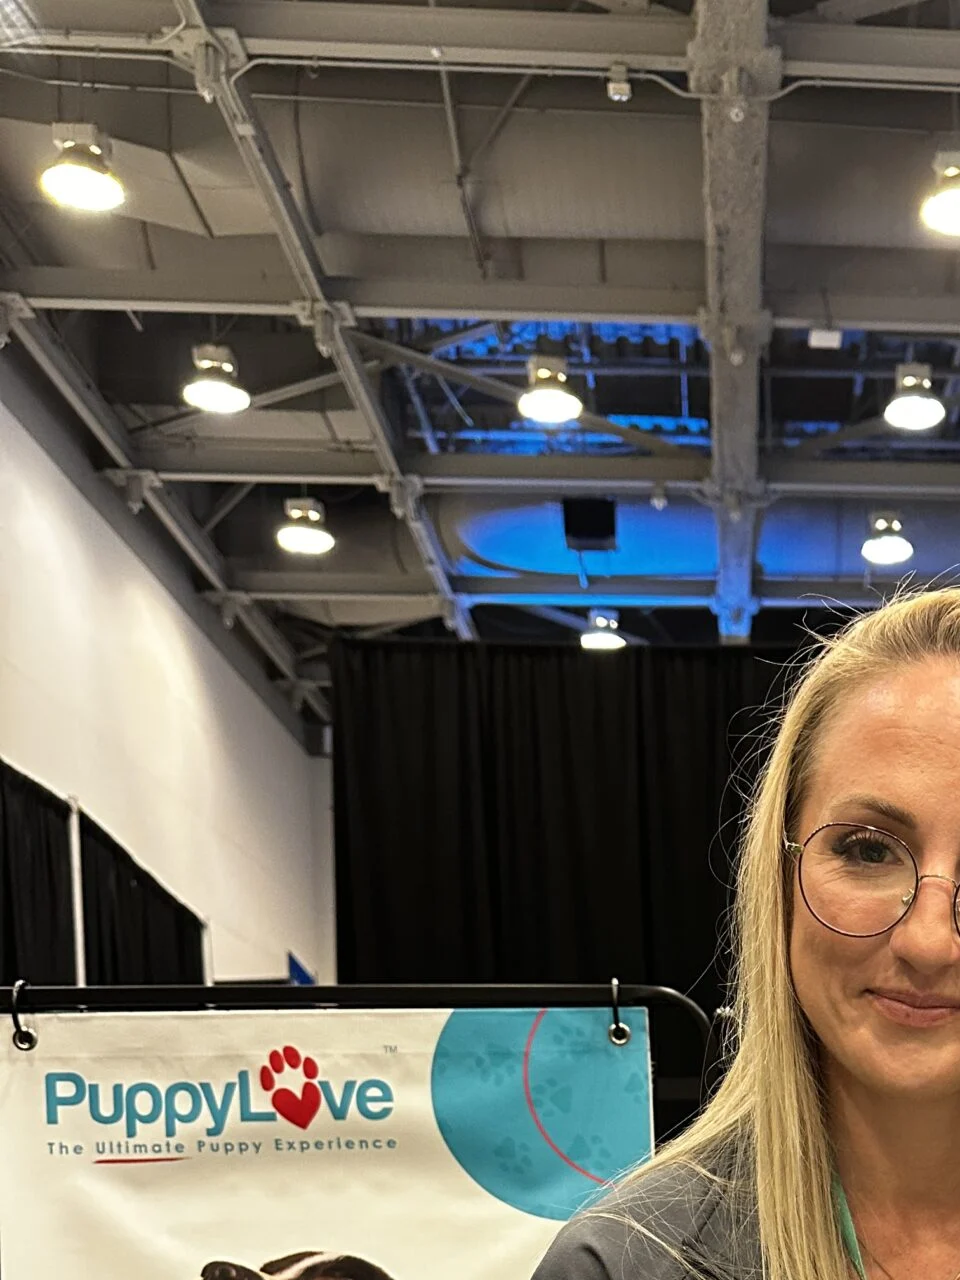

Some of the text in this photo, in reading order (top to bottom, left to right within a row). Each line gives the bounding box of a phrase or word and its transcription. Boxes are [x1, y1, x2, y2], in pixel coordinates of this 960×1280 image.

[47, 1136, 398, 1155] The Ultimate Puppy Experience
